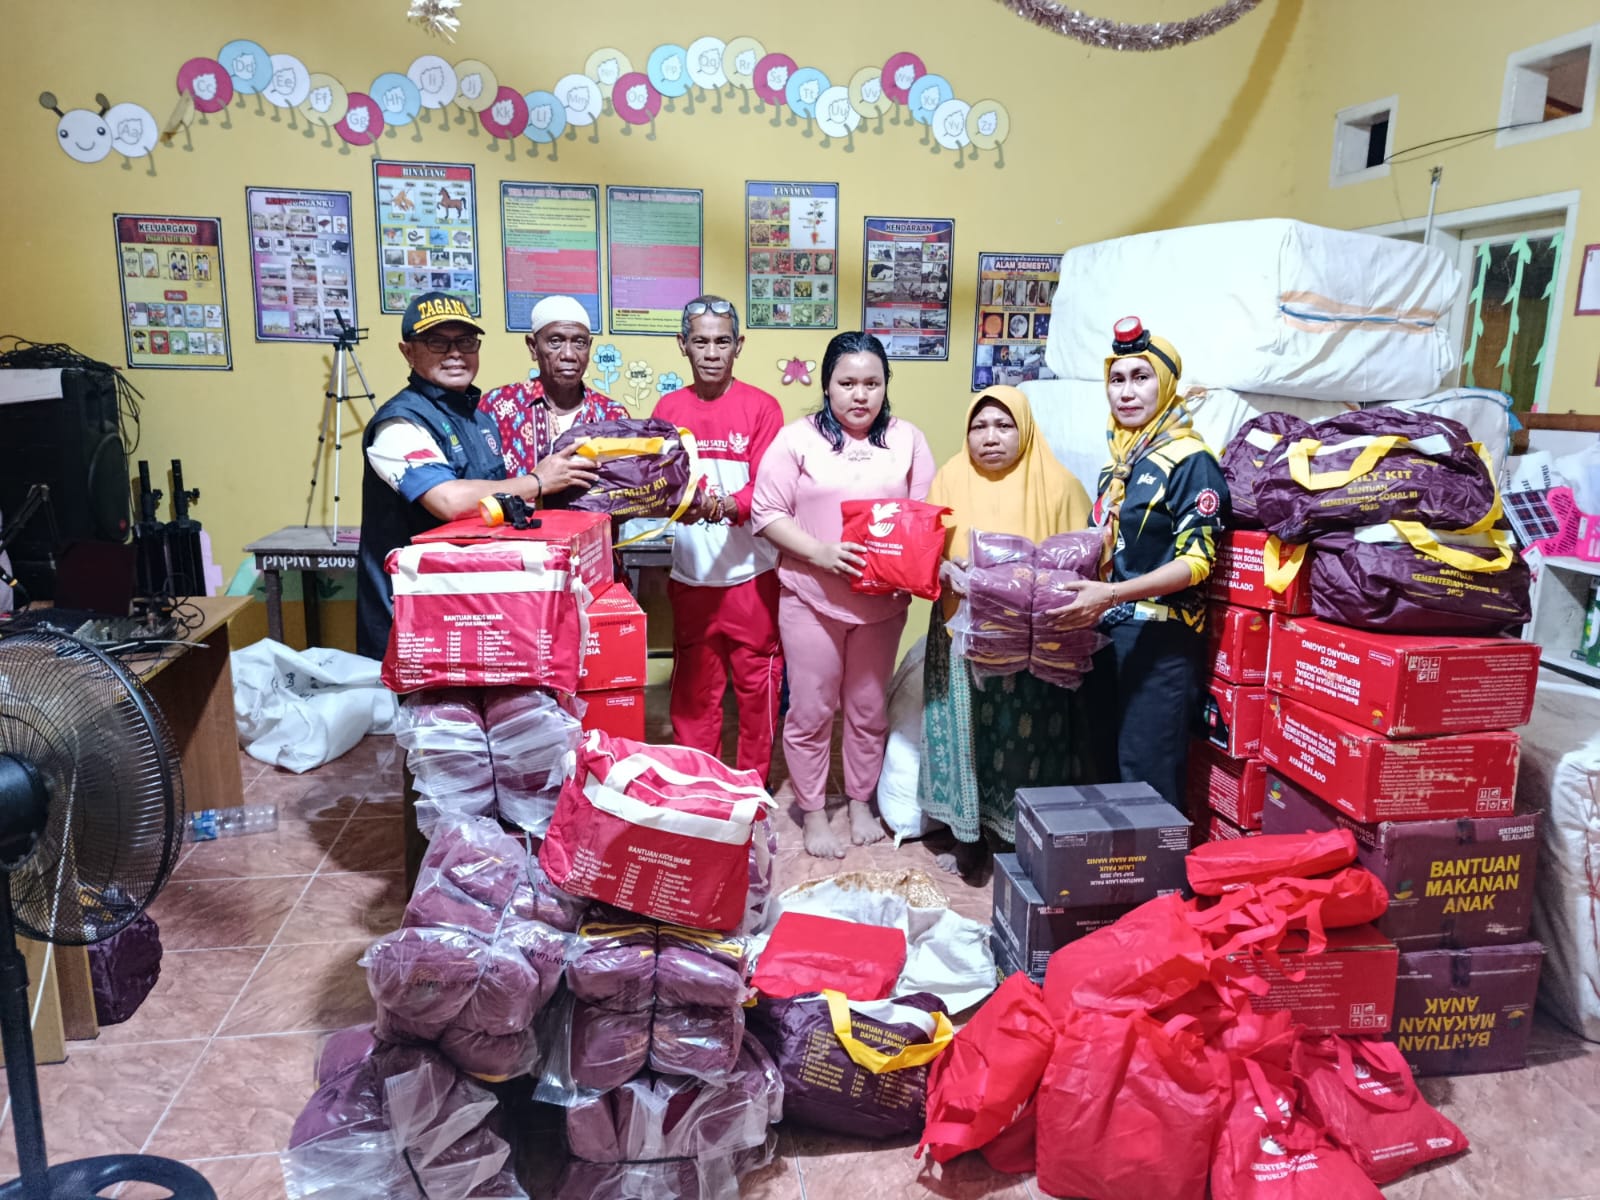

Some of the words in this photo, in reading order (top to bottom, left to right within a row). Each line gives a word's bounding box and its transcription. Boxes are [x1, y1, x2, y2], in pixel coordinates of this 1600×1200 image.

[235, 59, 255, 73] Dd
[276, 75, 293, 89] Ee
[769, 70, 782, 84] Ss
[196, 80, 214, 94] Cc
[315, 91, 328, 105] Ff
[386, 91, 404, 105] Hh
[627, 90, 645, 104] Oo
[496, 105, 512, 119] Kk
[831, 102, 849, 117] Uu
[349, 112, 367, 129] Gg
[121, 122, 139, 138] Aa
[402, 167, 446, 177] BINATANG
[773, 186, 812, 197] TANAMAN
[138, 222, 197, 234] KELUARGAKU
[886, 223, 933, 233] KENDARAAN
[995, 260, 1016, 270] ALAM
[1017, 261, 1050, 270] SEMESTA
[1385, 470, 1413, 481] KIT
[1347, 484, 1388, 495] BANTUAN
[317, 556, 356, 568] 2009
[1233, 562, 1264, 572] INDONESIA
[1228, 580, 1254, 592] BALADO
[1302, 640, 1326, 654] DAGING
[1320, 657, 1337, 669] 2025
[1327, 648, 1360, 665] RENDANG
[1295, 668, 1315, 681] SOSIAL
[1296, 660, 1327, 677] INDONESIA
[1316, 676, 1360, 697] KEMENTERIAN
[1284, 723, 1317, 747] KEMENTERIAN
[1318, 741, 1336, 758] SOSIAL
[1282, 730, 1307, 749] REPUBLIK
[1307, 745, 1336, 766] INDONESIA
[1300, 751, 1315, 766] 2025
[1289, 755, 1303, 770] AYAM
[1303, 764, 1326, 783] BALADO
[628, 845, 659, 858] BANTUAN
[659, 853, 674, 861] KIDS
[673, 856, 692, 866] WARE
[638, 855, 657, 864] DAFTAR
[1430, 854, 1521, 878] BANTUAN
[1425, 873, 1520, 897] MAKANAN
[1442, 894, 1497, 914] ANAK
[1424, 996, 1480, 1014] ANAK
[852, 1020, 883, 1037] BANTUAN
[1399, 1012, 1496, 1033] MAKANAN
[860, 1031, 882, 1042] DAFTAR
[1399, 1031, 1491, 1051] BANTUAN
